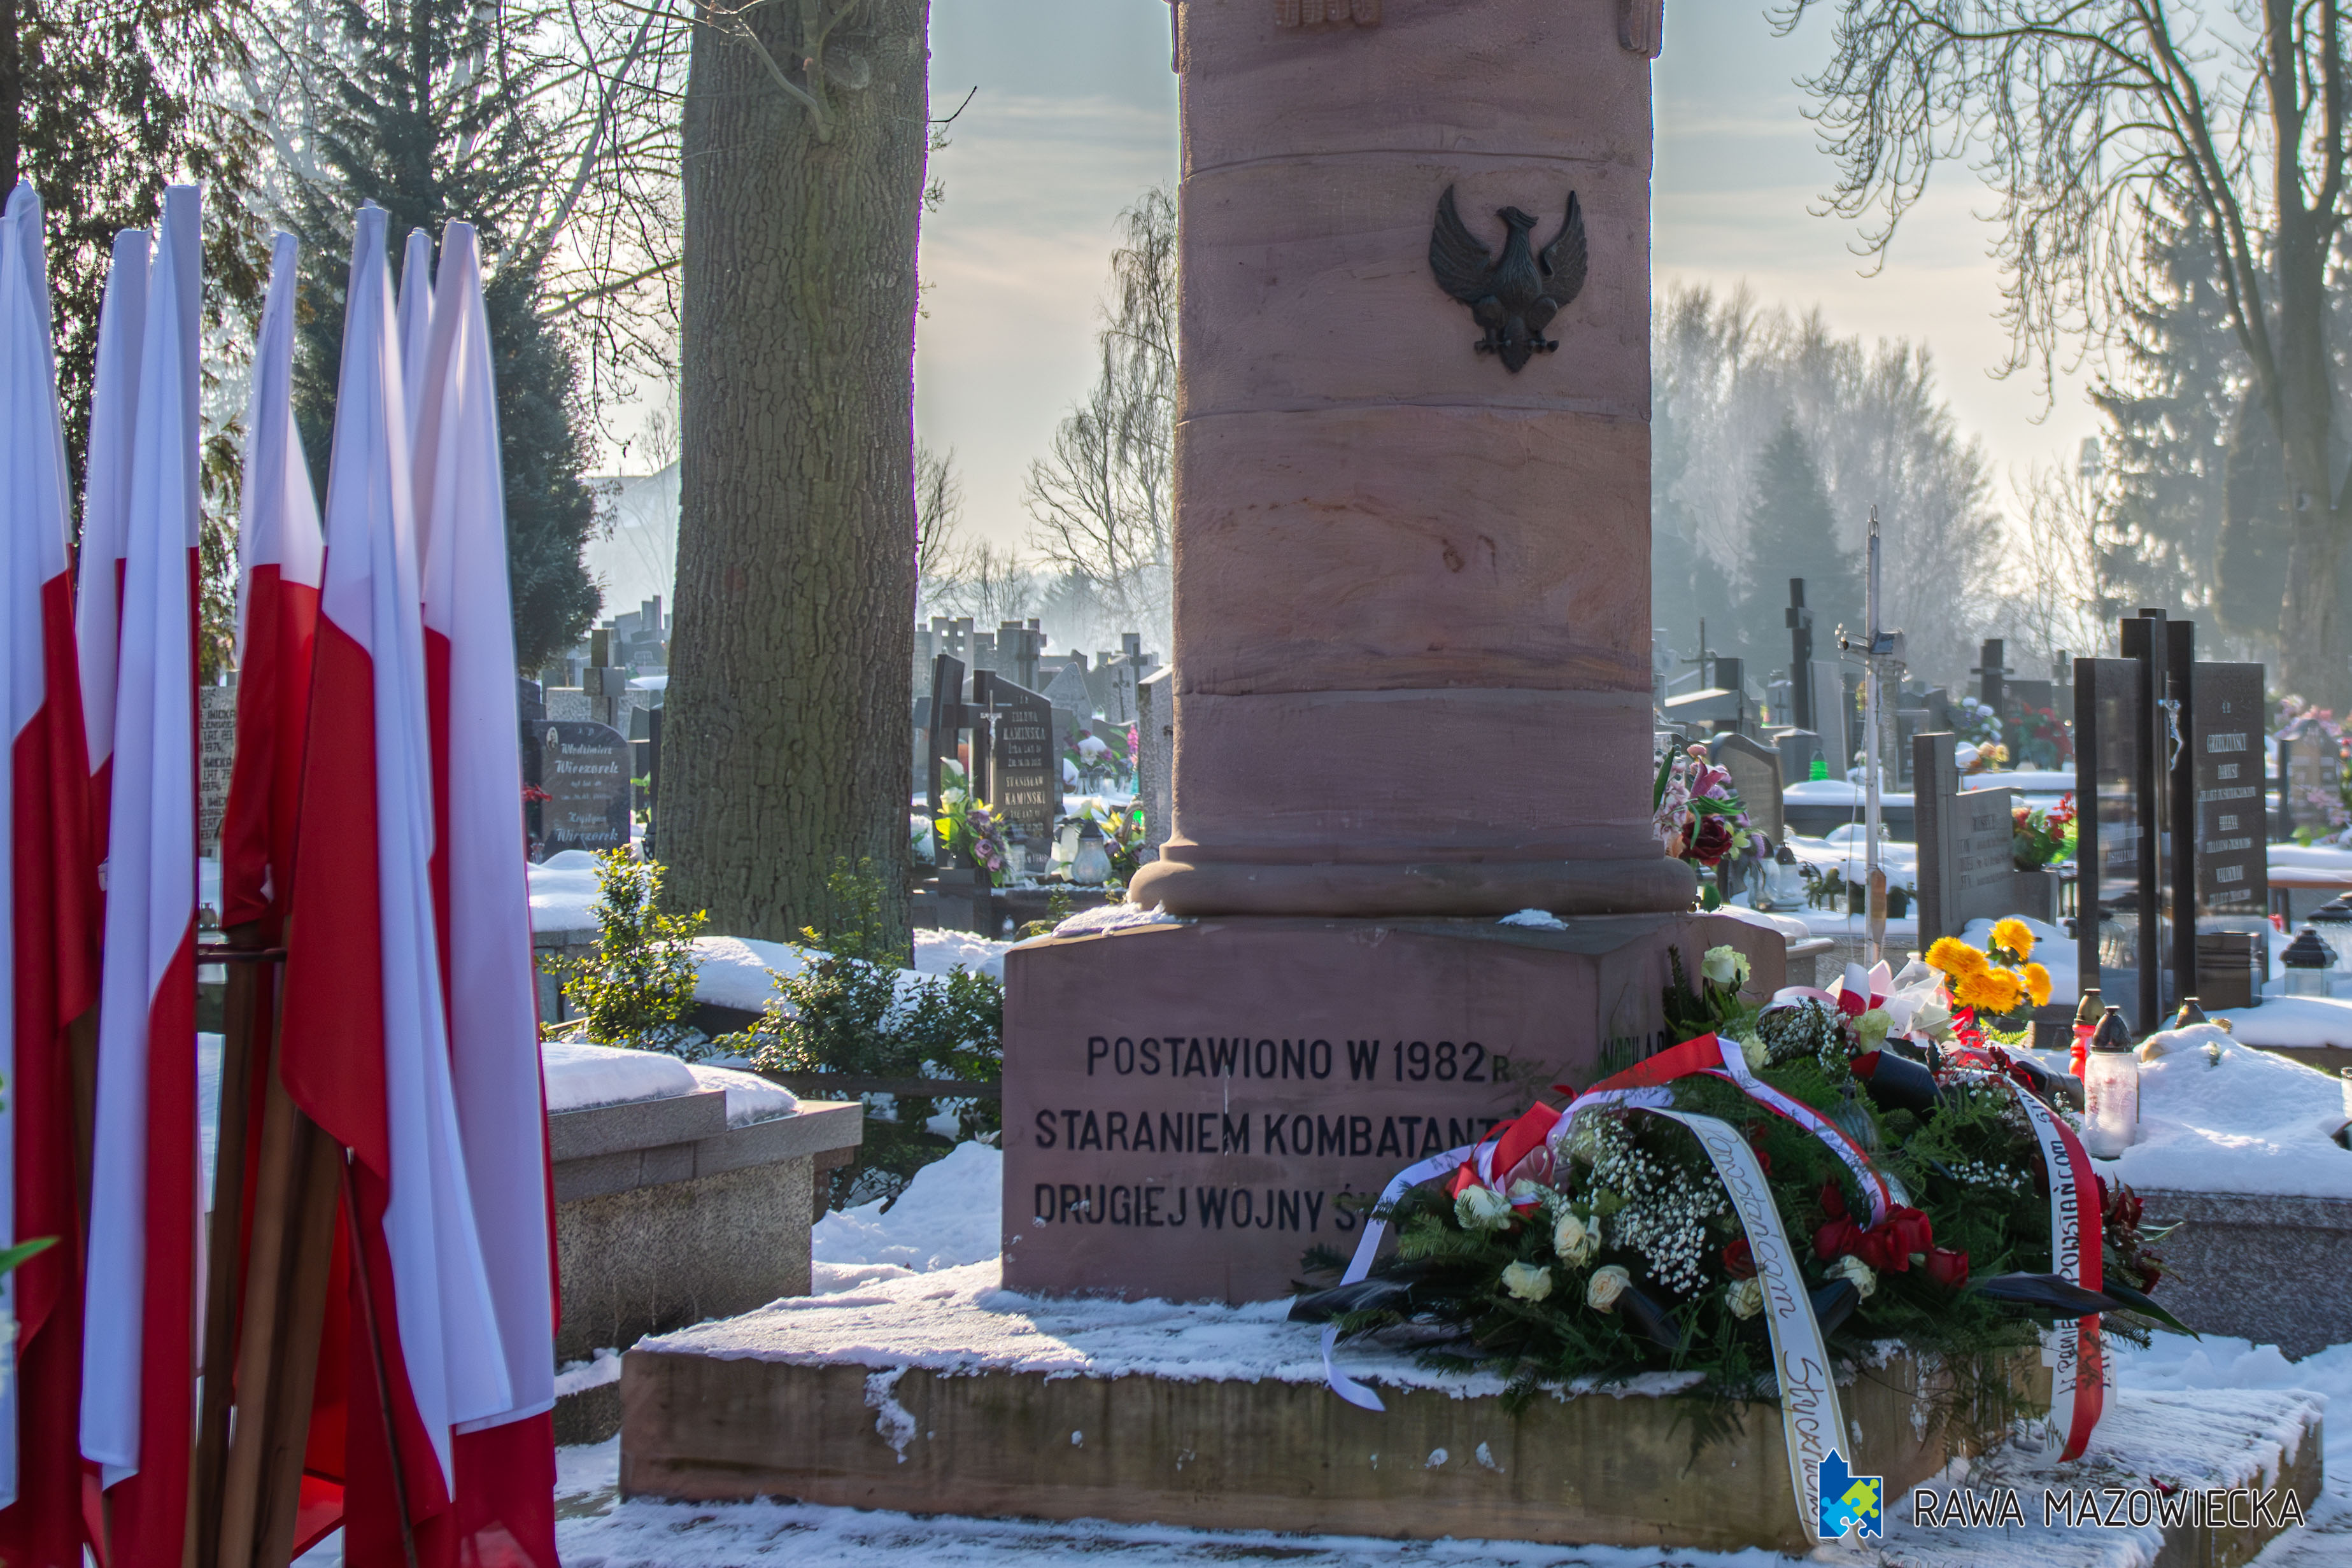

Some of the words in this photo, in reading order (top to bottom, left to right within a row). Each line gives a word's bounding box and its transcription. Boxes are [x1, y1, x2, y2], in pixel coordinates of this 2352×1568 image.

[1086, 1036, 1332, 1080] POSTAWIONO
[1347, 1040, 1380, 1081] W
[1035, 1108, 1250, 1155] STARANIEM
[1035, 1183, 1187, 1227] DRUGIEJ
[1197, 1185, 1326, 1233] WOJNY
